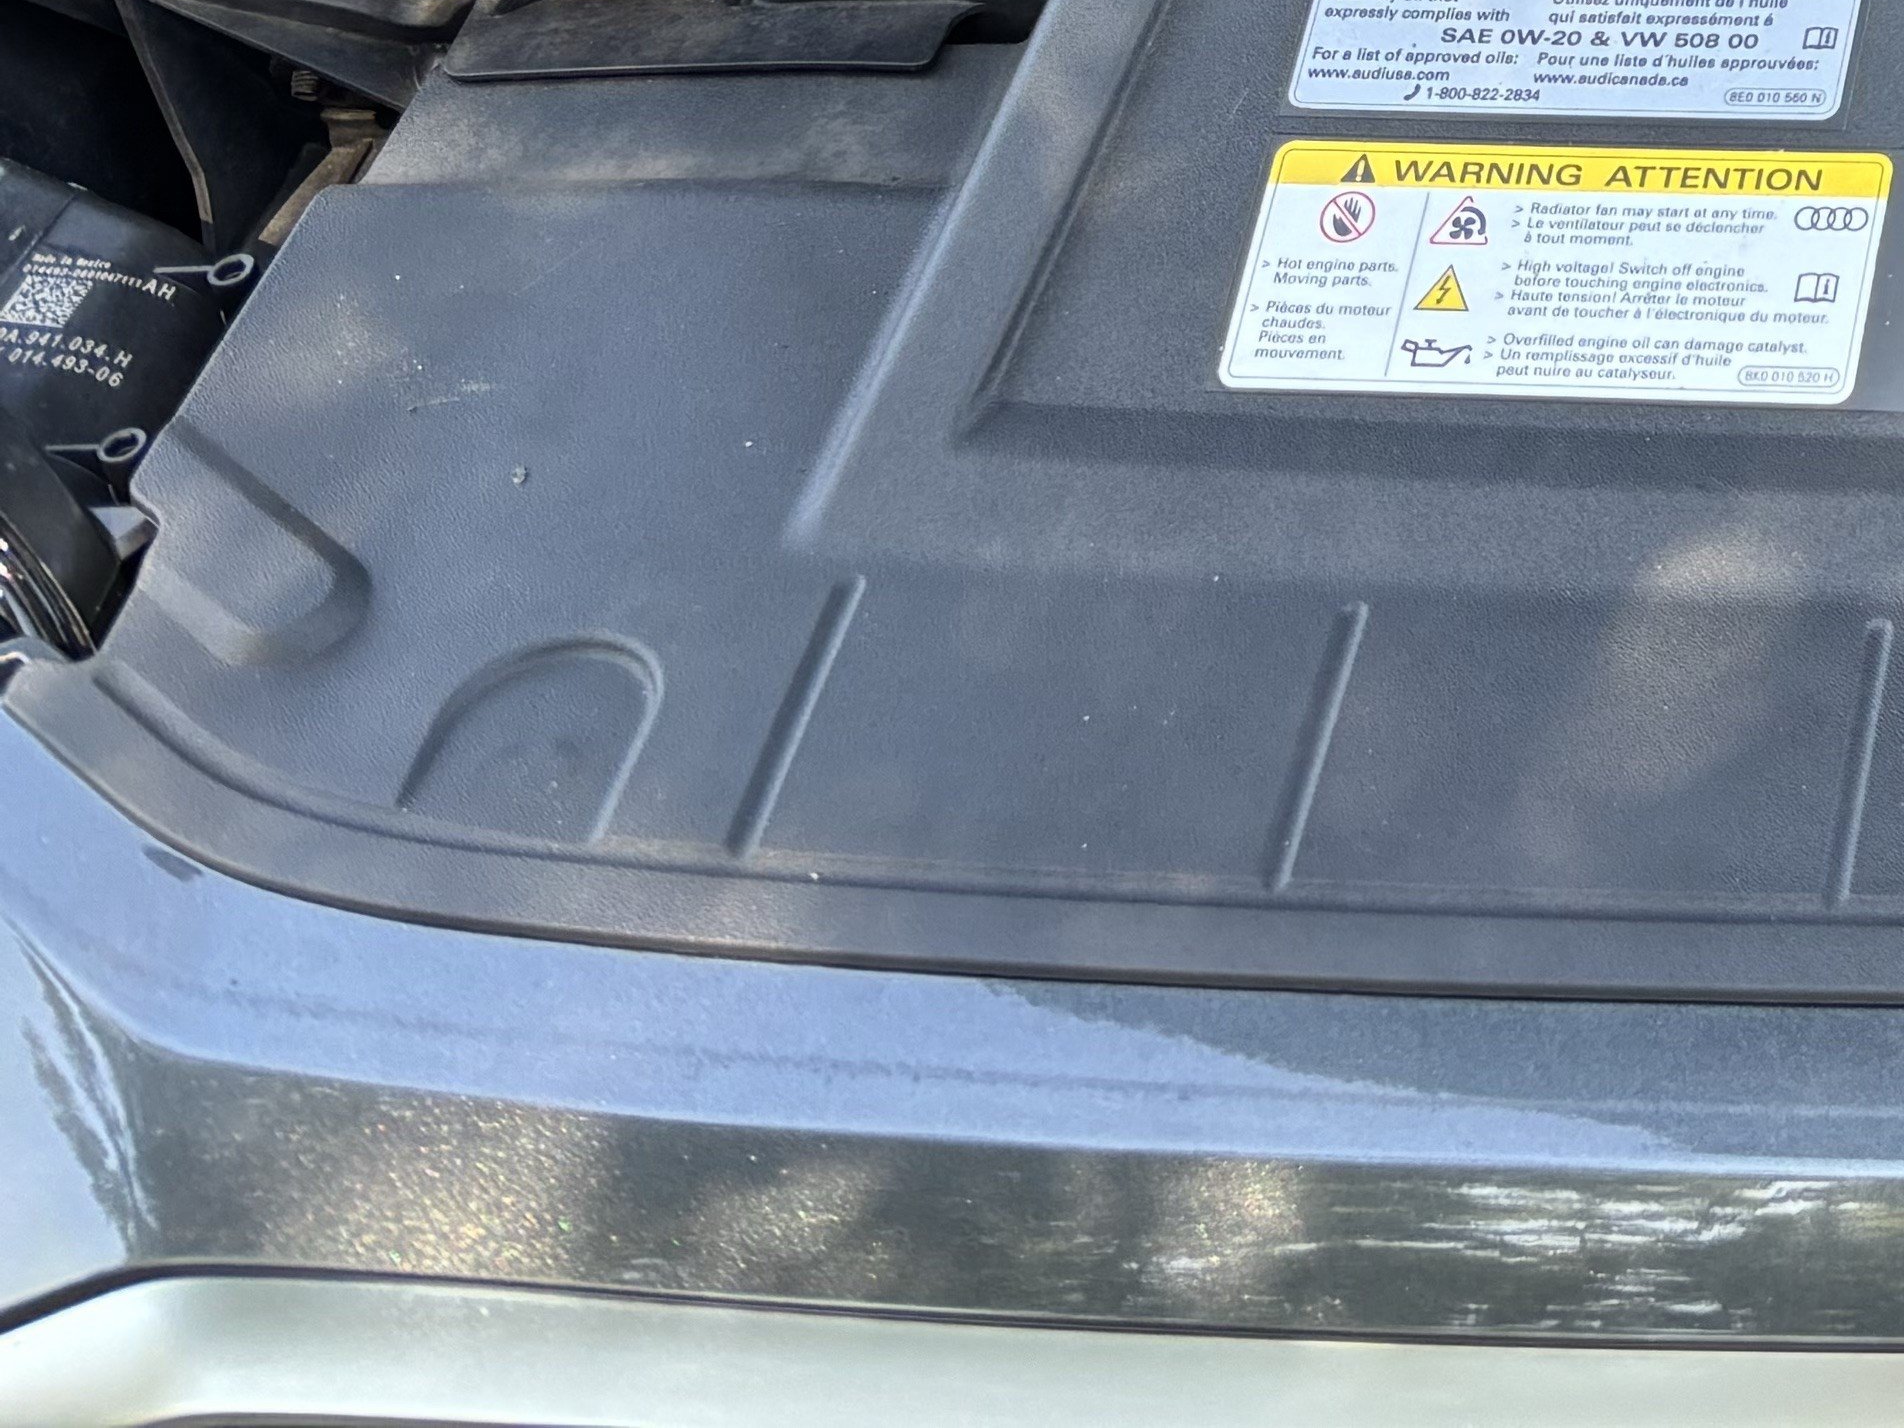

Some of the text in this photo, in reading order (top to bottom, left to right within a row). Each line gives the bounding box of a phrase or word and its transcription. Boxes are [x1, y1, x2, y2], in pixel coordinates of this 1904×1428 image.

[1325, 6, 1510, 22] expressly complies with
[1549, 10, 1575, 25] qui
[1579, 12, 1642, 25] satisfait
[1646, 12, 1760, 27] expressément
[1441, 27, 1759, 49] SAE 0W-20 & VW 508 00
[1312, 46, 1519, 65] For a list of approved oils:
[1537, 52, 1575, 66] Pour
[1579, 55, 1609, 66] une
[1614, 53, 1647, 67] liste
[1721, 55, 1820, 71] approuvées:
[1307, 67, 1450, 81] www.audiusa.com
[1533, 72, 1689, 87] www.audicanada.ca
[1426, 87, 1541, 101] 1-800-822-2834
[1757, 91, 1781, 103] 010
[1811, 93, 1822, 103] N
[1395, 159, 1823, 191] WARNING ATTENTION
[1530, 202, 1778, 222] Radiator fan may start at any time.
[1527, 217, 1766, 234] Le ventilateur peut se déclencher
[1537, 232, 1565, 244] tout
[1569, 234, 1633, 246] moment.
[1277, 257, 1399, 275] Hot engine parts.
[1517, 259, 1746, 279] High voltage! Switch off engine
[1273, 272, 1372, 288] Moving parts.
[1514, 275, 1769, 293] before touching engine electronics.
[142, 278, 178, 301] AH
[1510, 289, 1746, 307] Haute tension! Arrêter le moteur
[1266, 301, 1393, 317] Pièces du moteur
[1507, 306, 1547, 317] avant
[1552, 306, 1570, 317] de
[1574, 307, 1630, 319] toucher
[1750, 311, 1768, 322] du
[1773, 313, 1829, 325] moteur.
[1262, 317, 1326, 330] chaudes.
[1258, 330, 1326, 344] Pièces en
[1504, 332, 1808, 354] Overfilled engine oil can damage catalyst.
[1254, 347, 1345, 360] mouvement.
[1500, 348, 1521, 360] Un
[1525, 350, 1614, 365] remplissage
[1619, 352, 1678, 365] excessif
[1496, 365, 1676, 381] peut nuire au catalyseur.
